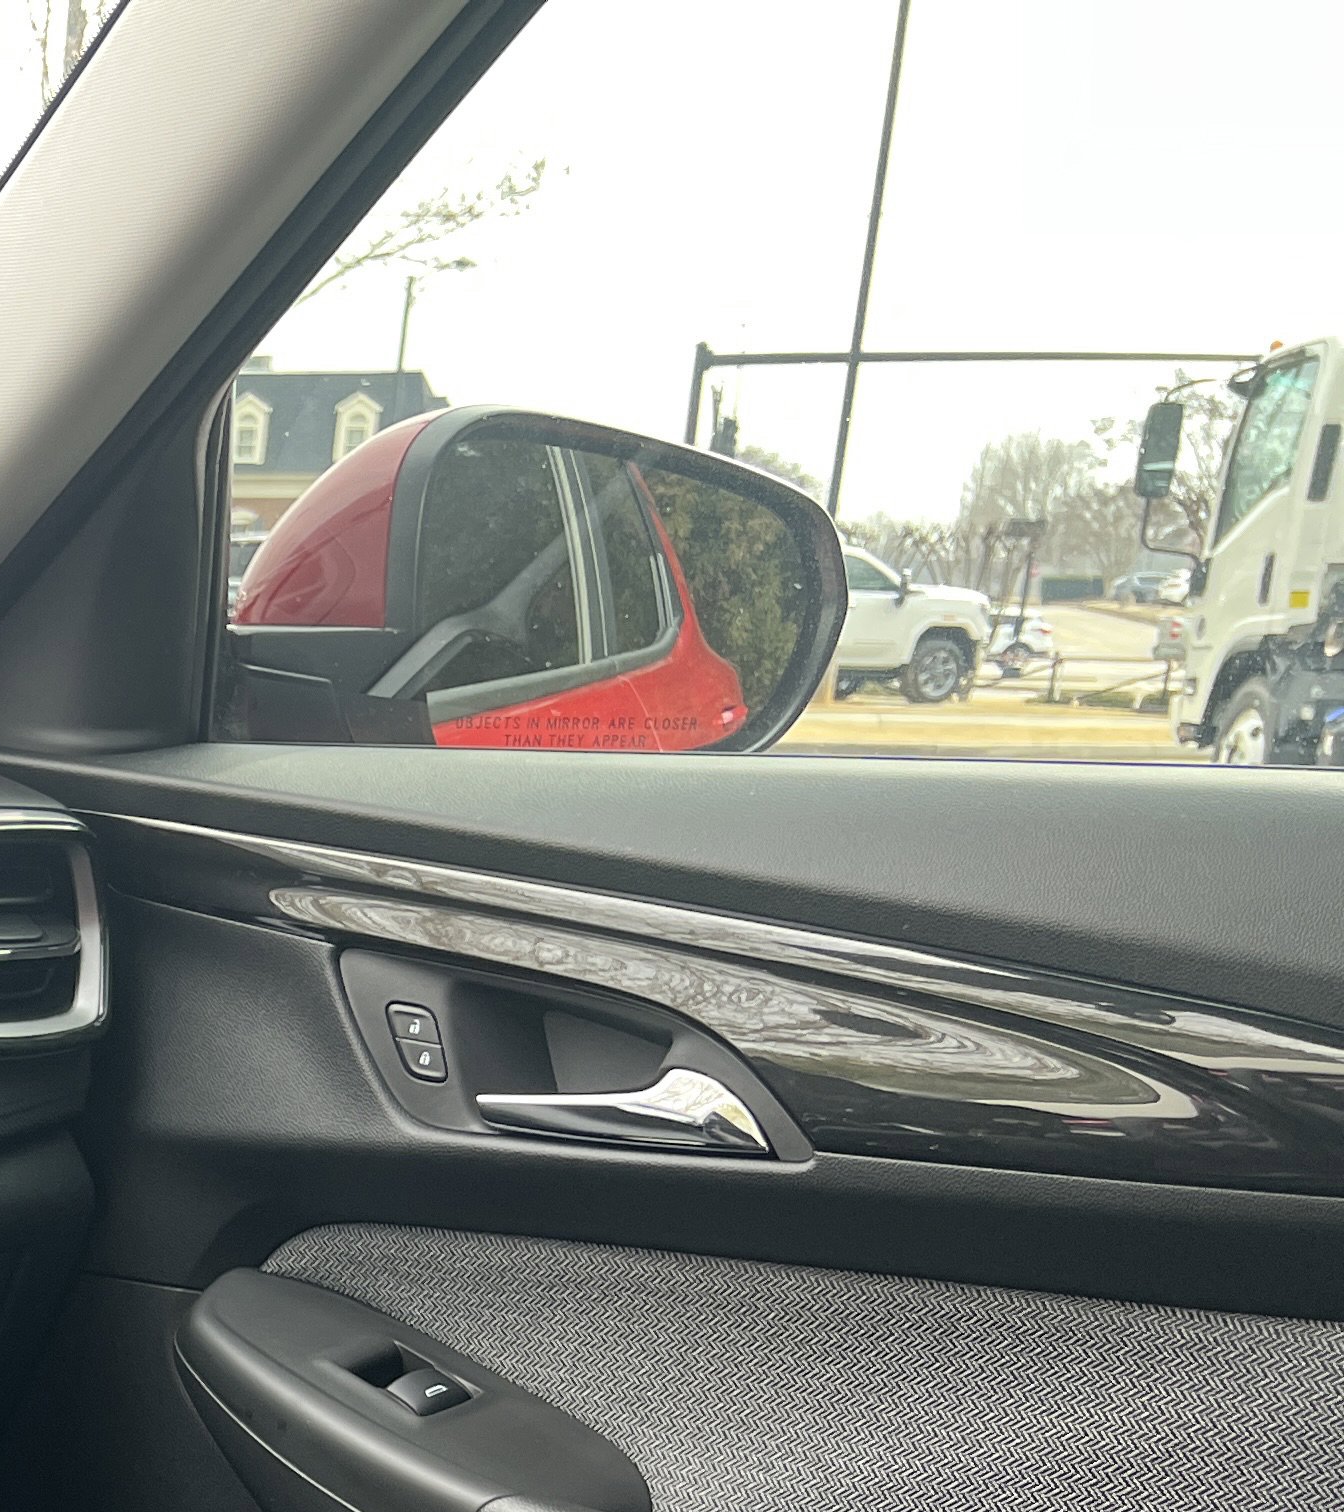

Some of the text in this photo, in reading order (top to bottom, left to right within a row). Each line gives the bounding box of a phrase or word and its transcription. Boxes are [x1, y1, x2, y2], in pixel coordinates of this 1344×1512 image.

[455, 716, 699, 730] OBJECTS IN MIRROR ARE CLOSER
[504, 734, 647, 748] THAN THEY APPEAR
